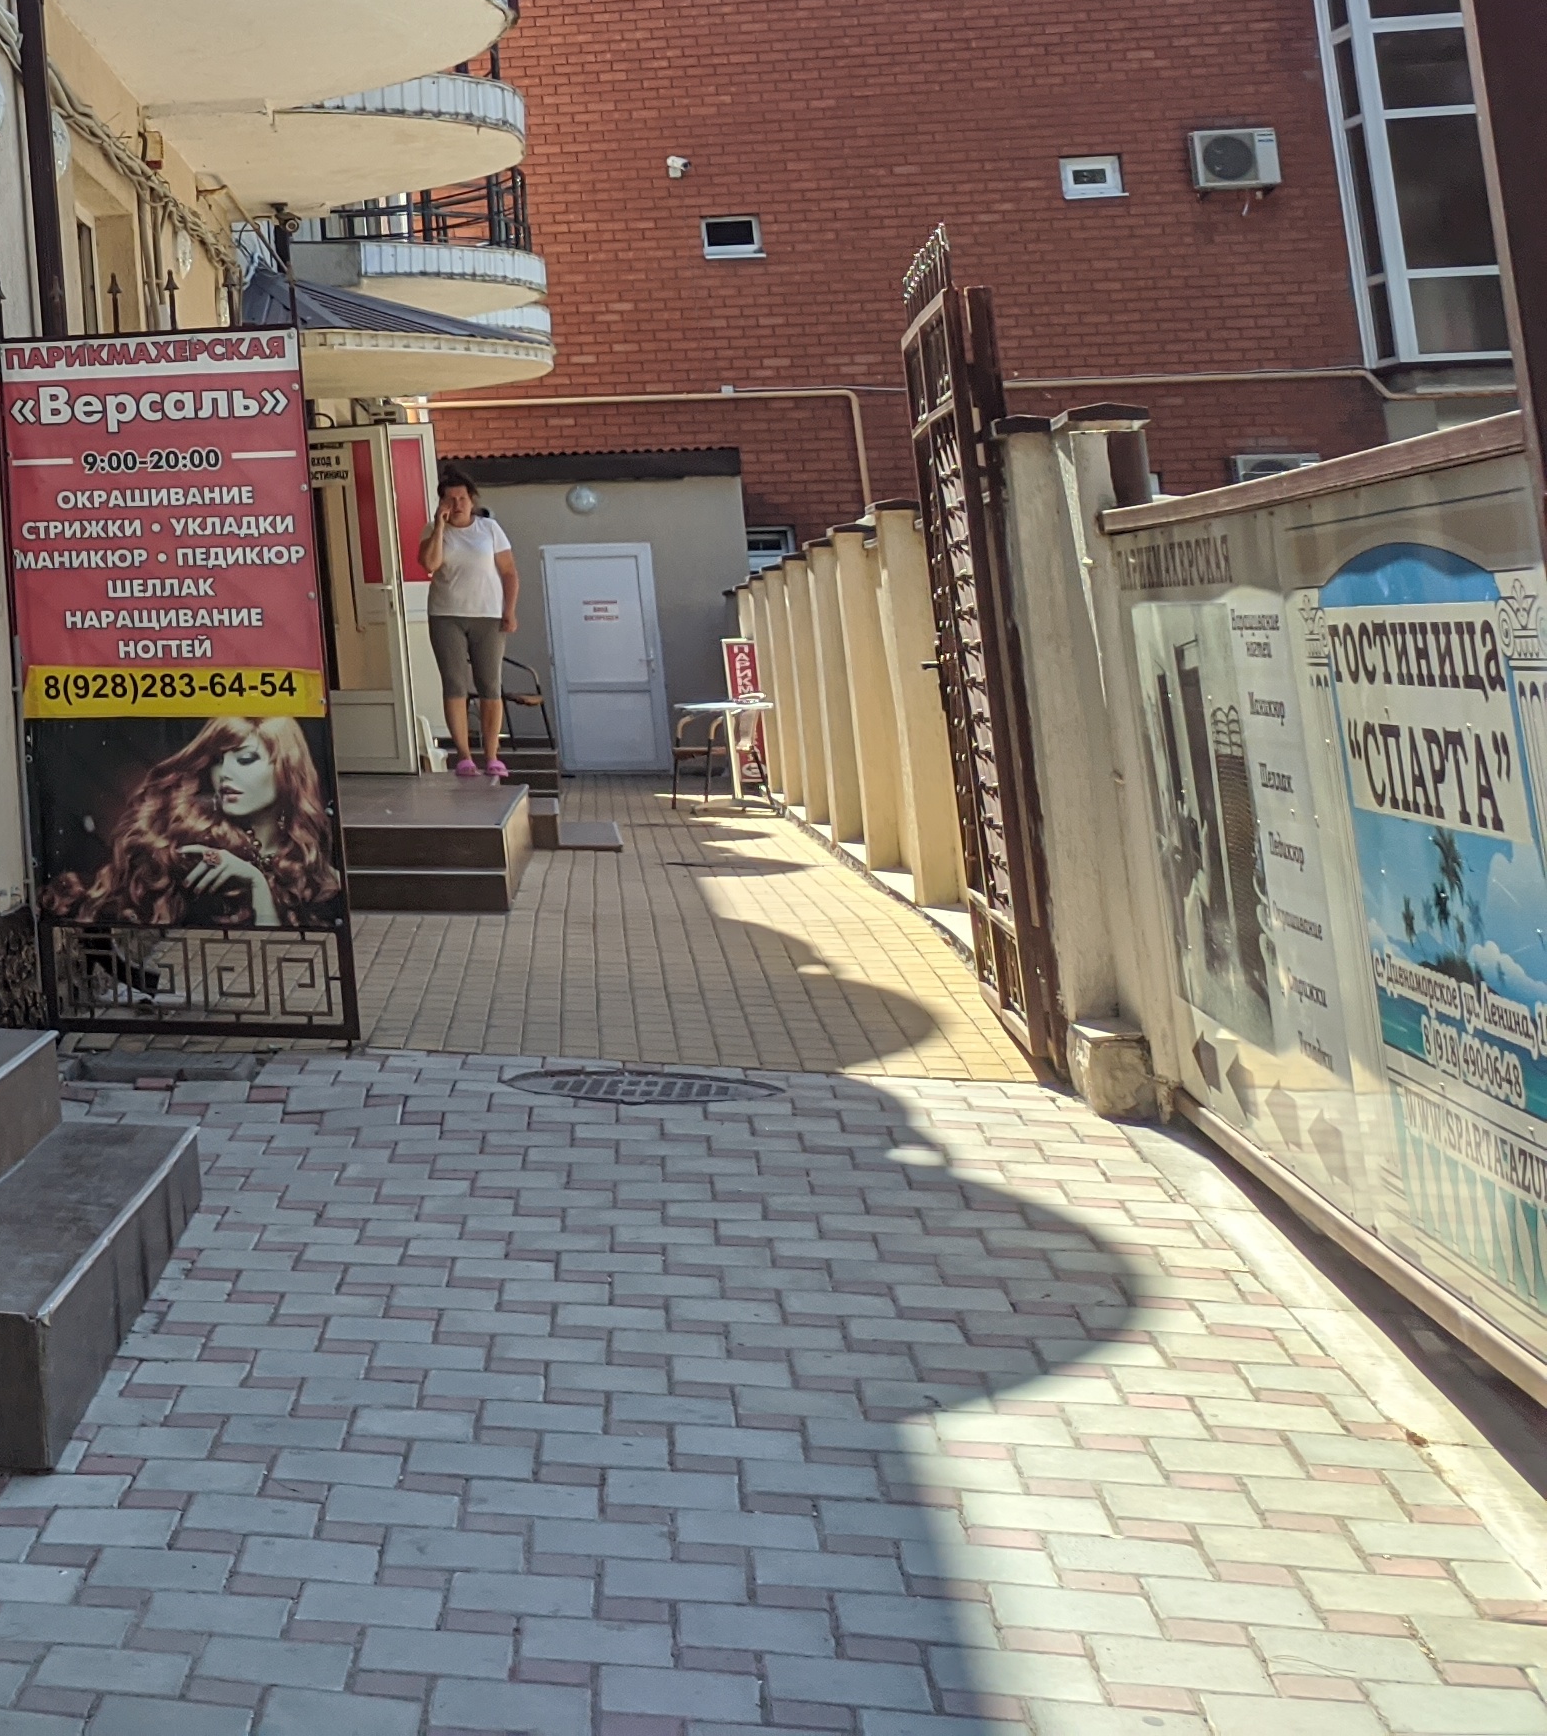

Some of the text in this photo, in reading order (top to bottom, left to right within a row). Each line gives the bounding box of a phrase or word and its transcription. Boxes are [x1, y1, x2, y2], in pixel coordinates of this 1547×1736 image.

[6, 335, 285, 370] ПАРИКМАХЕРСКАЯ
[10, 385, 289, 433] «Версаль»
[81, 447, 222, 473] 9:00-20:00
[55, 485, 255, 509] ОКРАШИВАНИЕ
[21, 515, 295, 540] СТРИЖКИ УКЛАДКИ
[14, 545, 306, 570] МАНИКЮР ПЕДИКЮР
[106, 577, 216, 599] ШЕЛЛАК
[64, 607, 264, 631] НАРАЩИВАНИЕ
[118, 634, 213, 659] НОГТЕЙ
[43, 671, 298, 706] 8(928)283-64-54
[1463, 990, 1480, 1021] ул.
[1422, 1022, 1432, 1055] 8
[1462, 1040, 1524, 1100] 490-06-48
